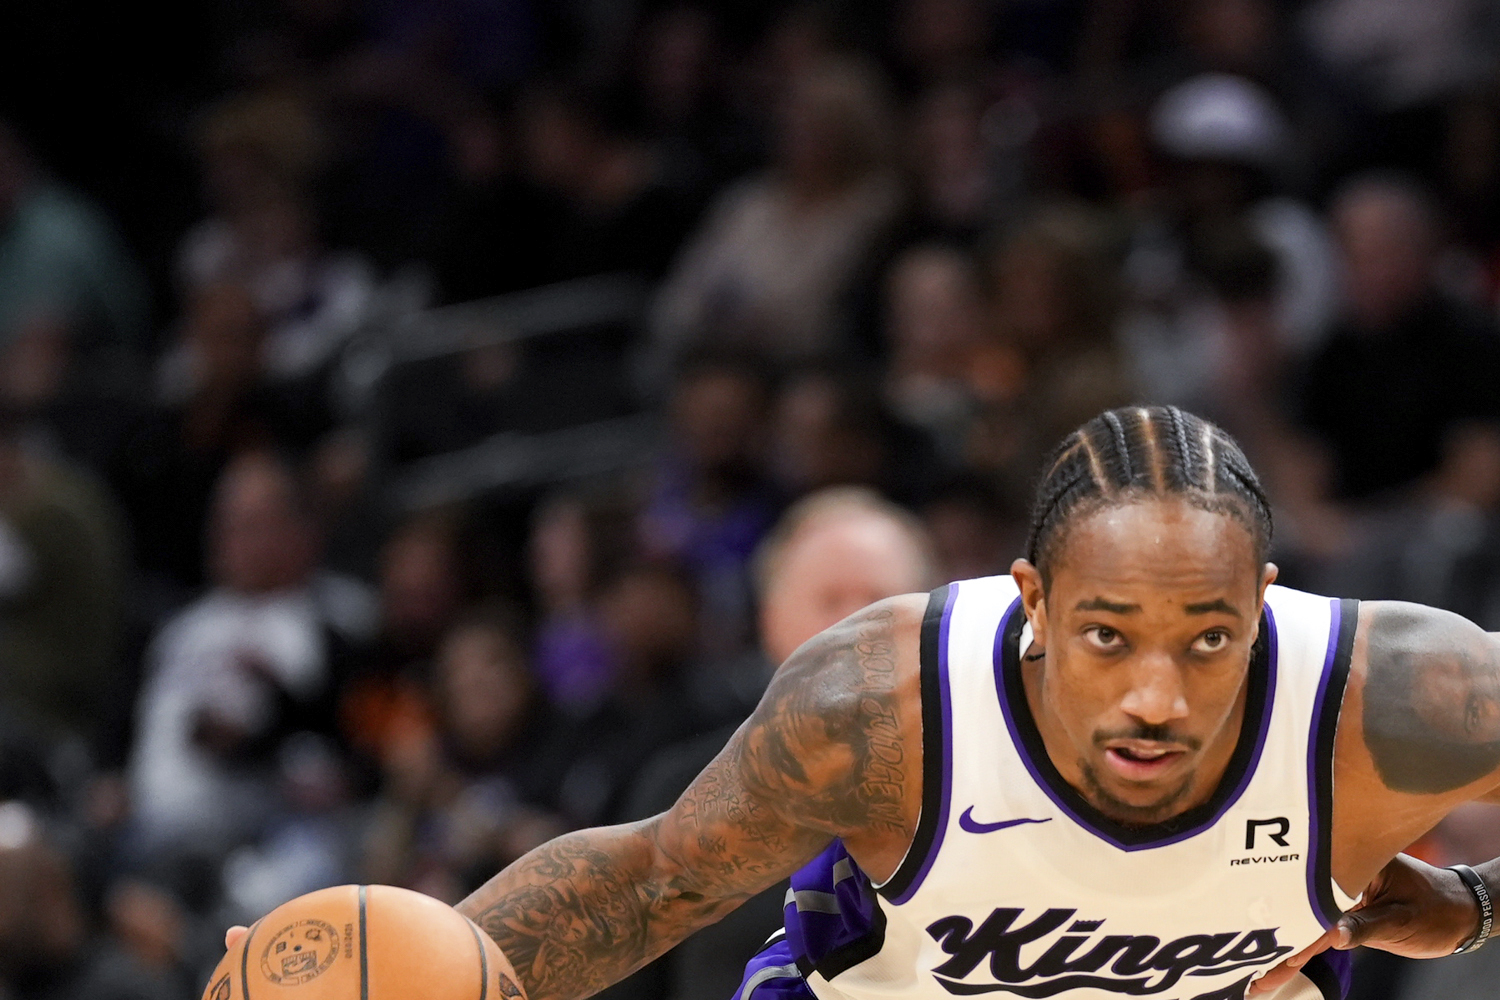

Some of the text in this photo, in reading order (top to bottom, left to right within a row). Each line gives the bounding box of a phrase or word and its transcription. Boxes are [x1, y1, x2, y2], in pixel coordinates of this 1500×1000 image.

[1245, 816, 1290, 850] R
[1230, 853, 1300, 867] REVIVER
[1473, 883, 1493, 917] PERSON
[925, 907, 1294, 998] Kings
